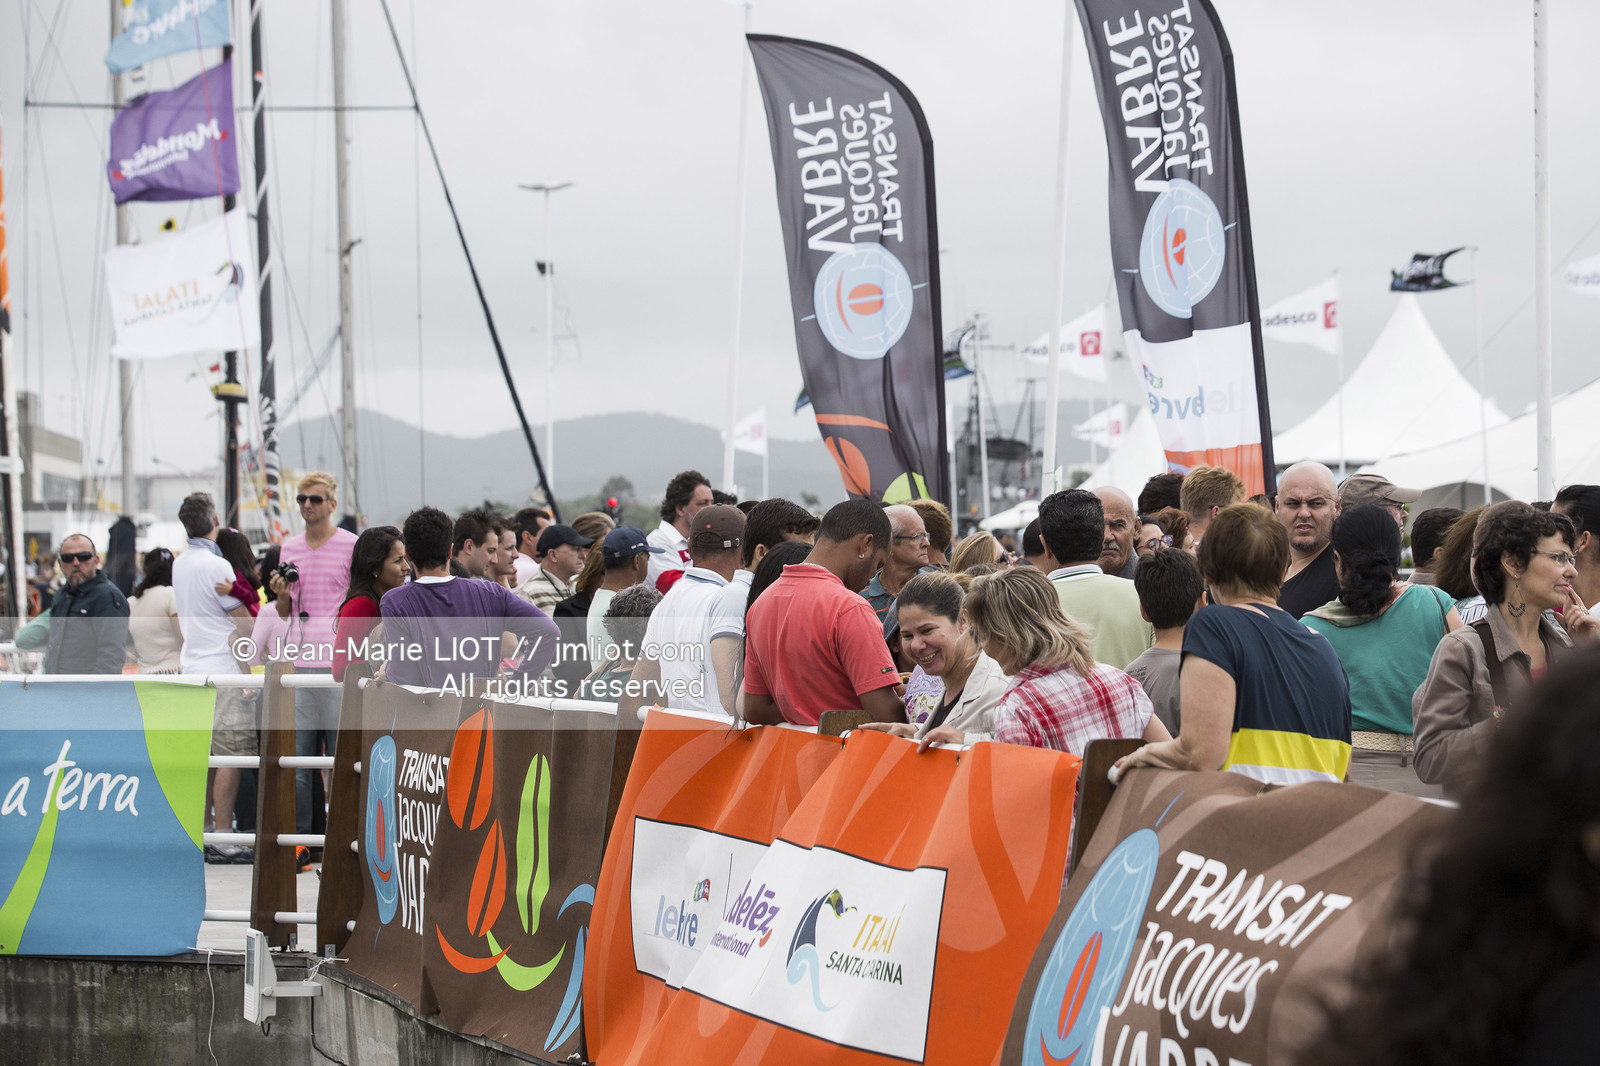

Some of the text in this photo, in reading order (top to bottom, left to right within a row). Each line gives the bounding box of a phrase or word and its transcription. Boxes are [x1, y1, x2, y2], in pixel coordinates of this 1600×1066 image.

[1, 739, 140, 817] a terra
[1155, 850, 1353, 949] TRANSAT
